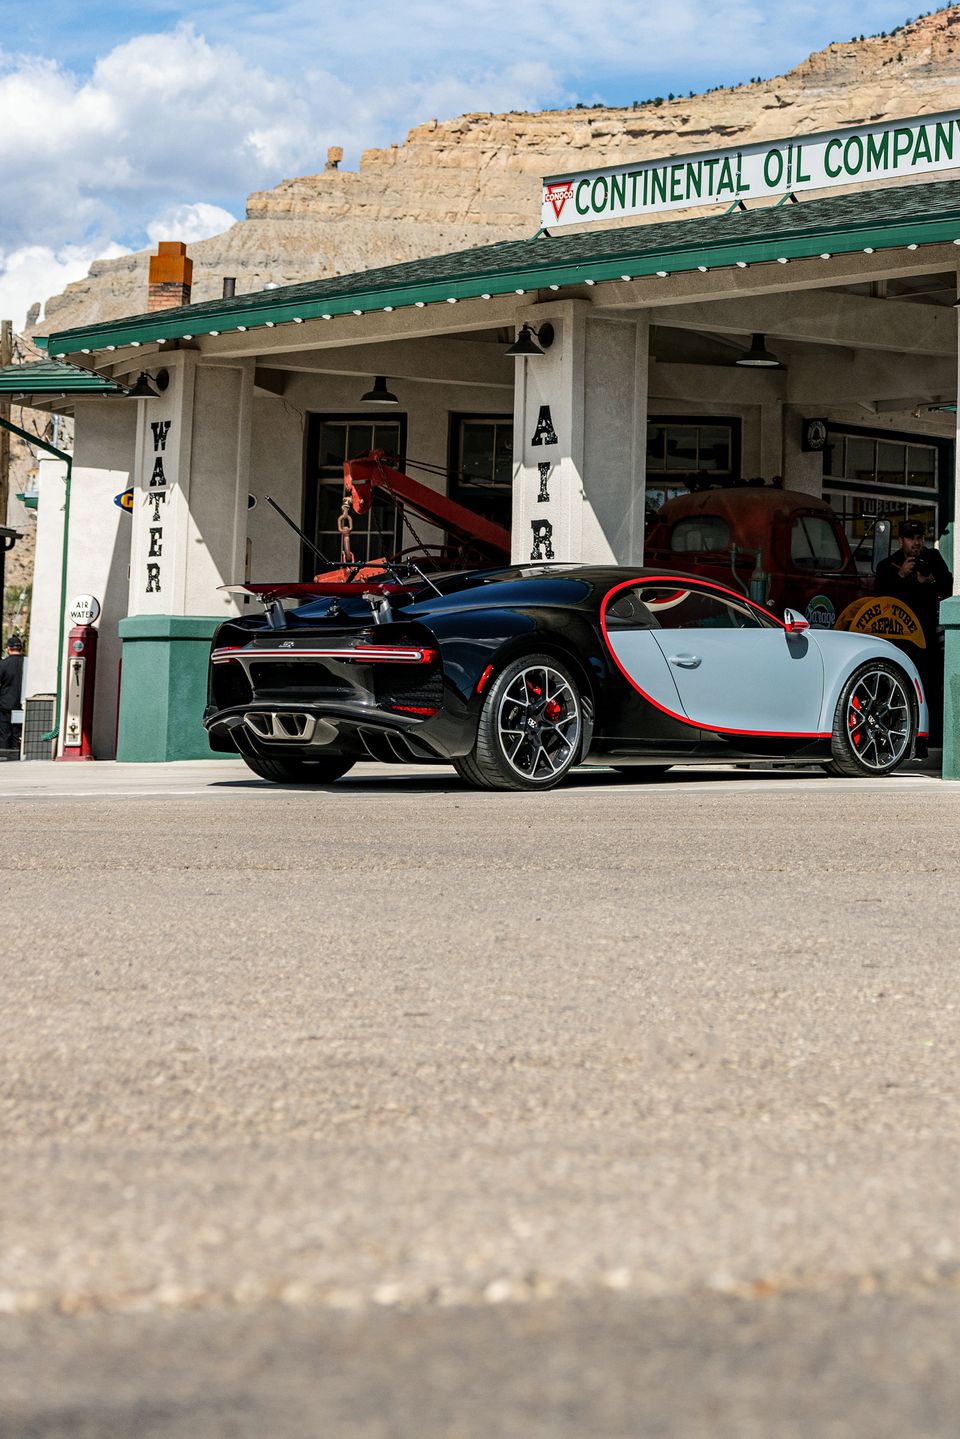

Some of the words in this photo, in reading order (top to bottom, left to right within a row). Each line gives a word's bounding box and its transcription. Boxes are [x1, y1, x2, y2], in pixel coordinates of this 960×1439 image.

[575, 152, 750, 215] CONTINENTAL
[763, 143, 811, 188] OIL
[545, 190, 573, 202] CONOCO
[530, 405, 558, 560] AIR
[145, 420, 171, 593] WATER
[70, 611, 94, 619] WATER
[75, 601, 89, 609] AIR
[856, 604, 882, 630] TIRE
[892, 604, 918, 633] TUBE
[871, 617, 904, 635] REPAIR
